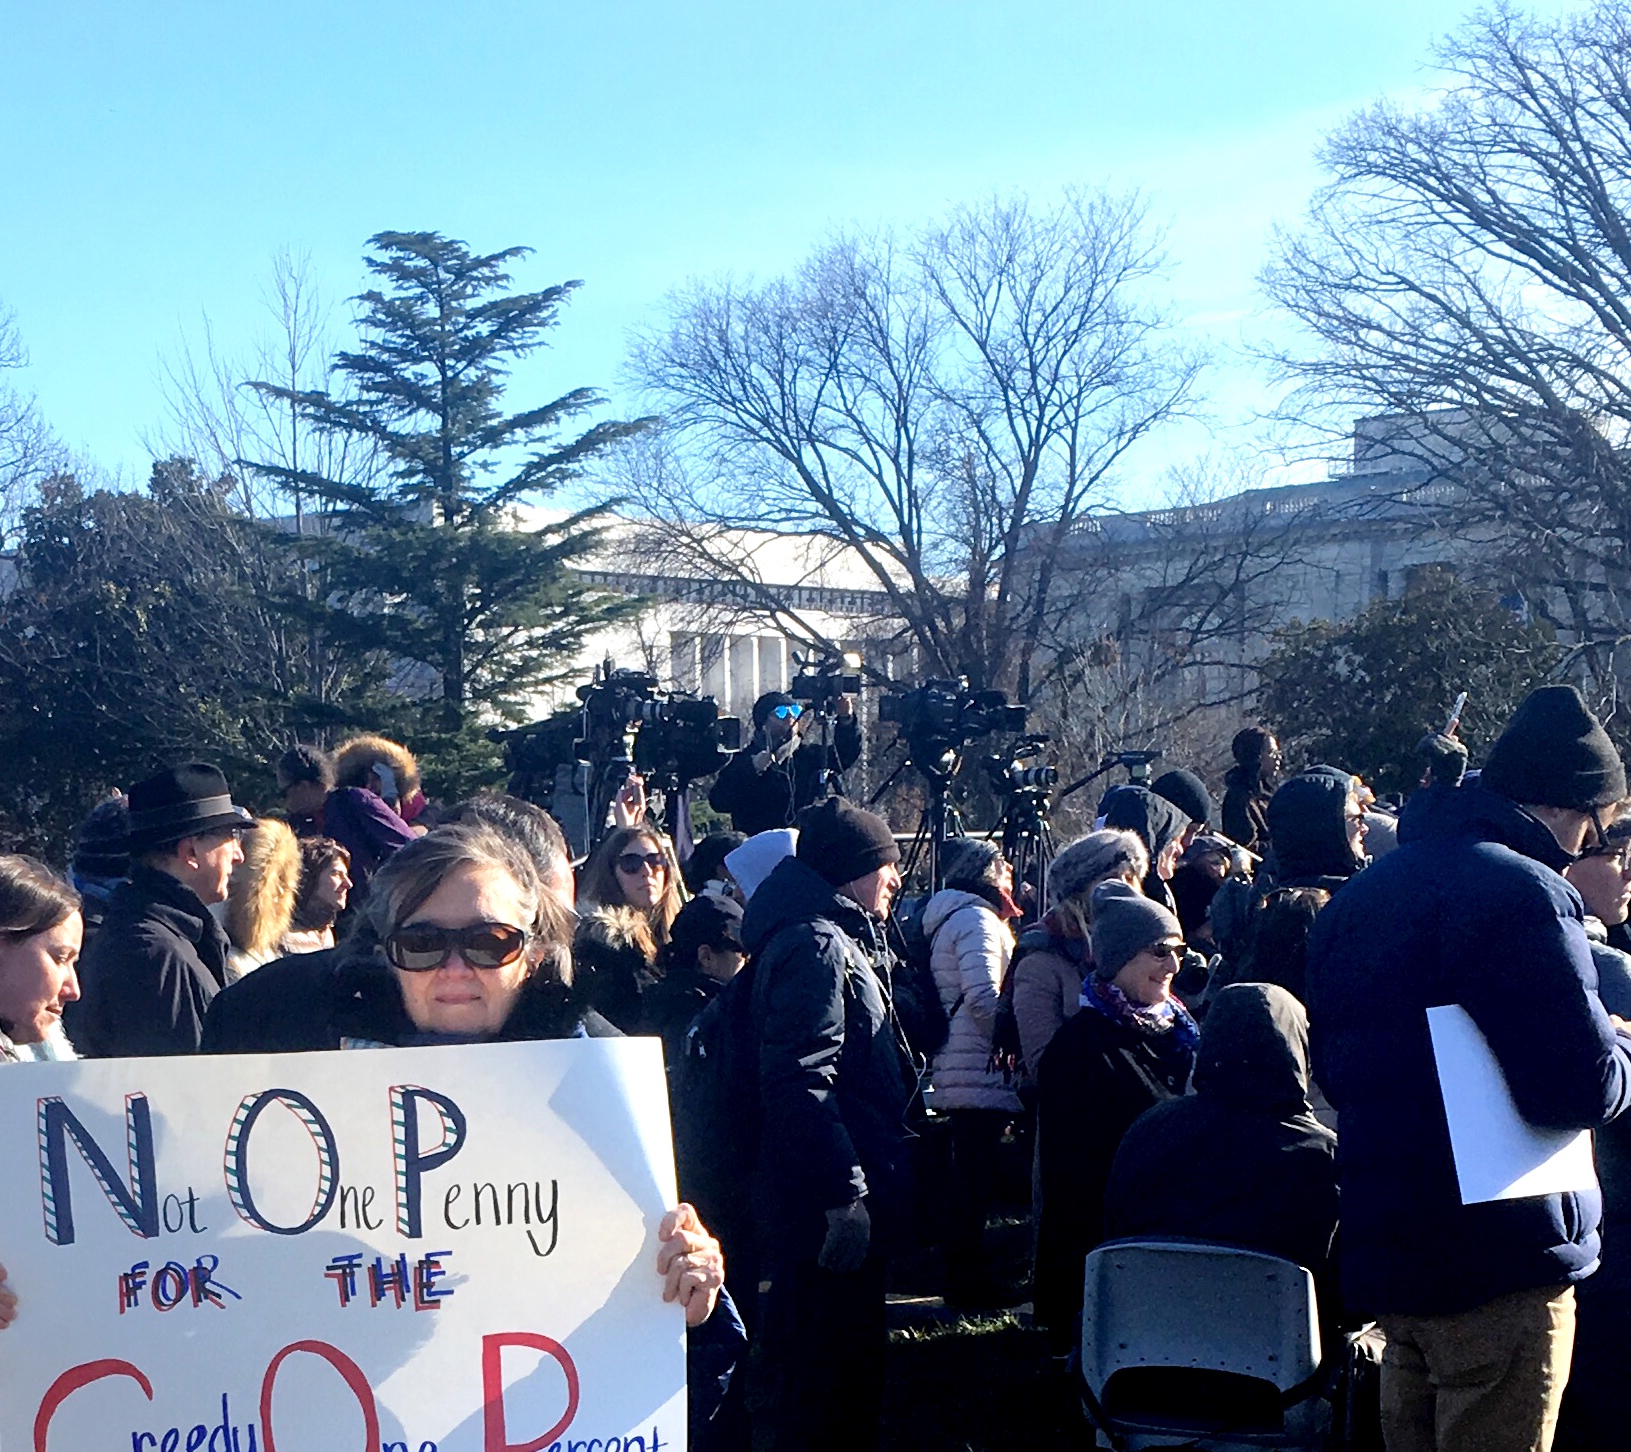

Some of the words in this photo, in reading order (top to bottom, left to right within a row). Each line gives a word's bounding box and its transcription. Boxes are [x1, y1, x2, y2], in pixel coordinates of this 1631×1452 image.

[35, 1090, 208, 1246] Not
[223, 1087, 384, 1236] One
[388, 1084, 559, 1257] Penny
[119, 1254, 242, 1315] FOR
[323, 1250, 455, 1313] THE
